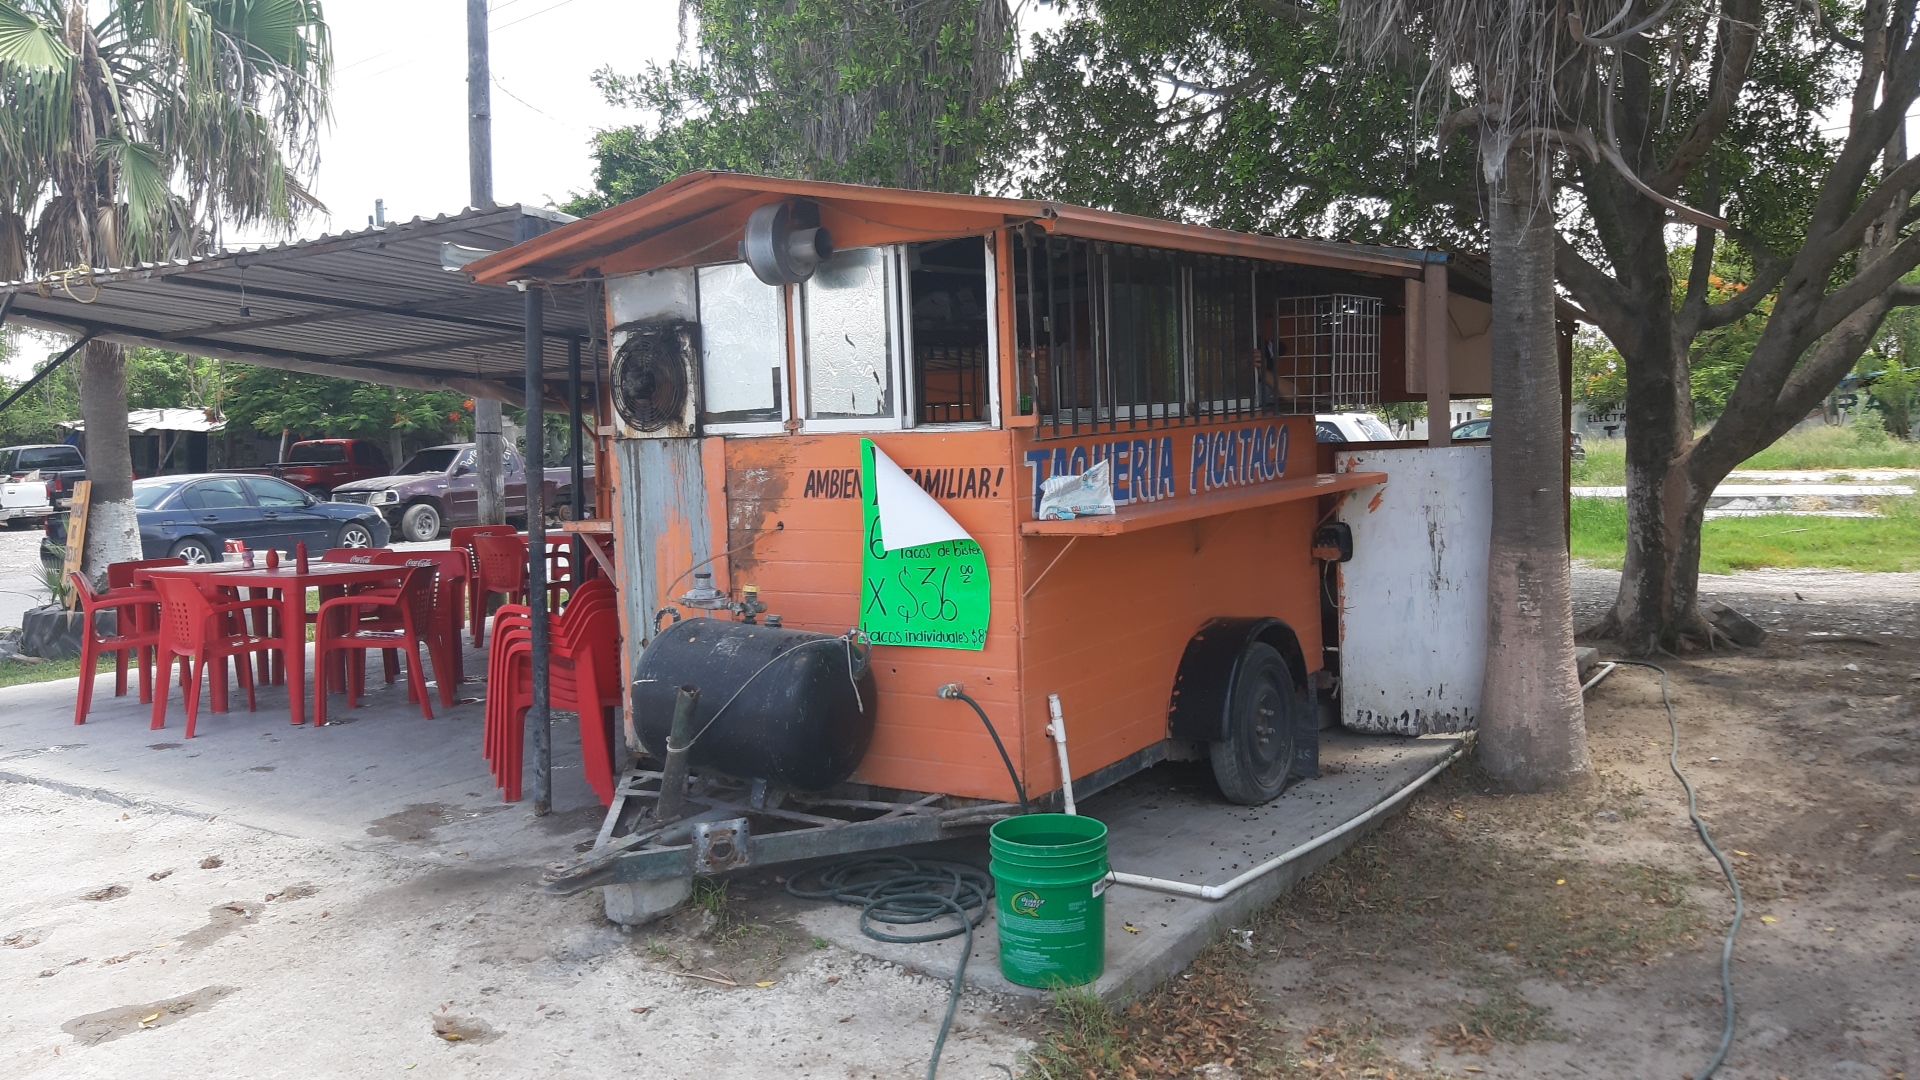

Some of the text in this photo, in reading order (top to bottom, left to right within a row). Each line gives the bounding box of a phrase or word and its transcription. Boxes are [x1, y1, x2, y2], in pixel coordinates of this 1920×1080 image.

[1190, 424, 1289, 495] PICATACO
[902, 467, 1004, 499] AMILIAR!
[870, 515, 888, 560] 6
[938, 544, 950, 557] de
[897, 565, 958, 624] $36
[905, 629, 969, 644] individuales
